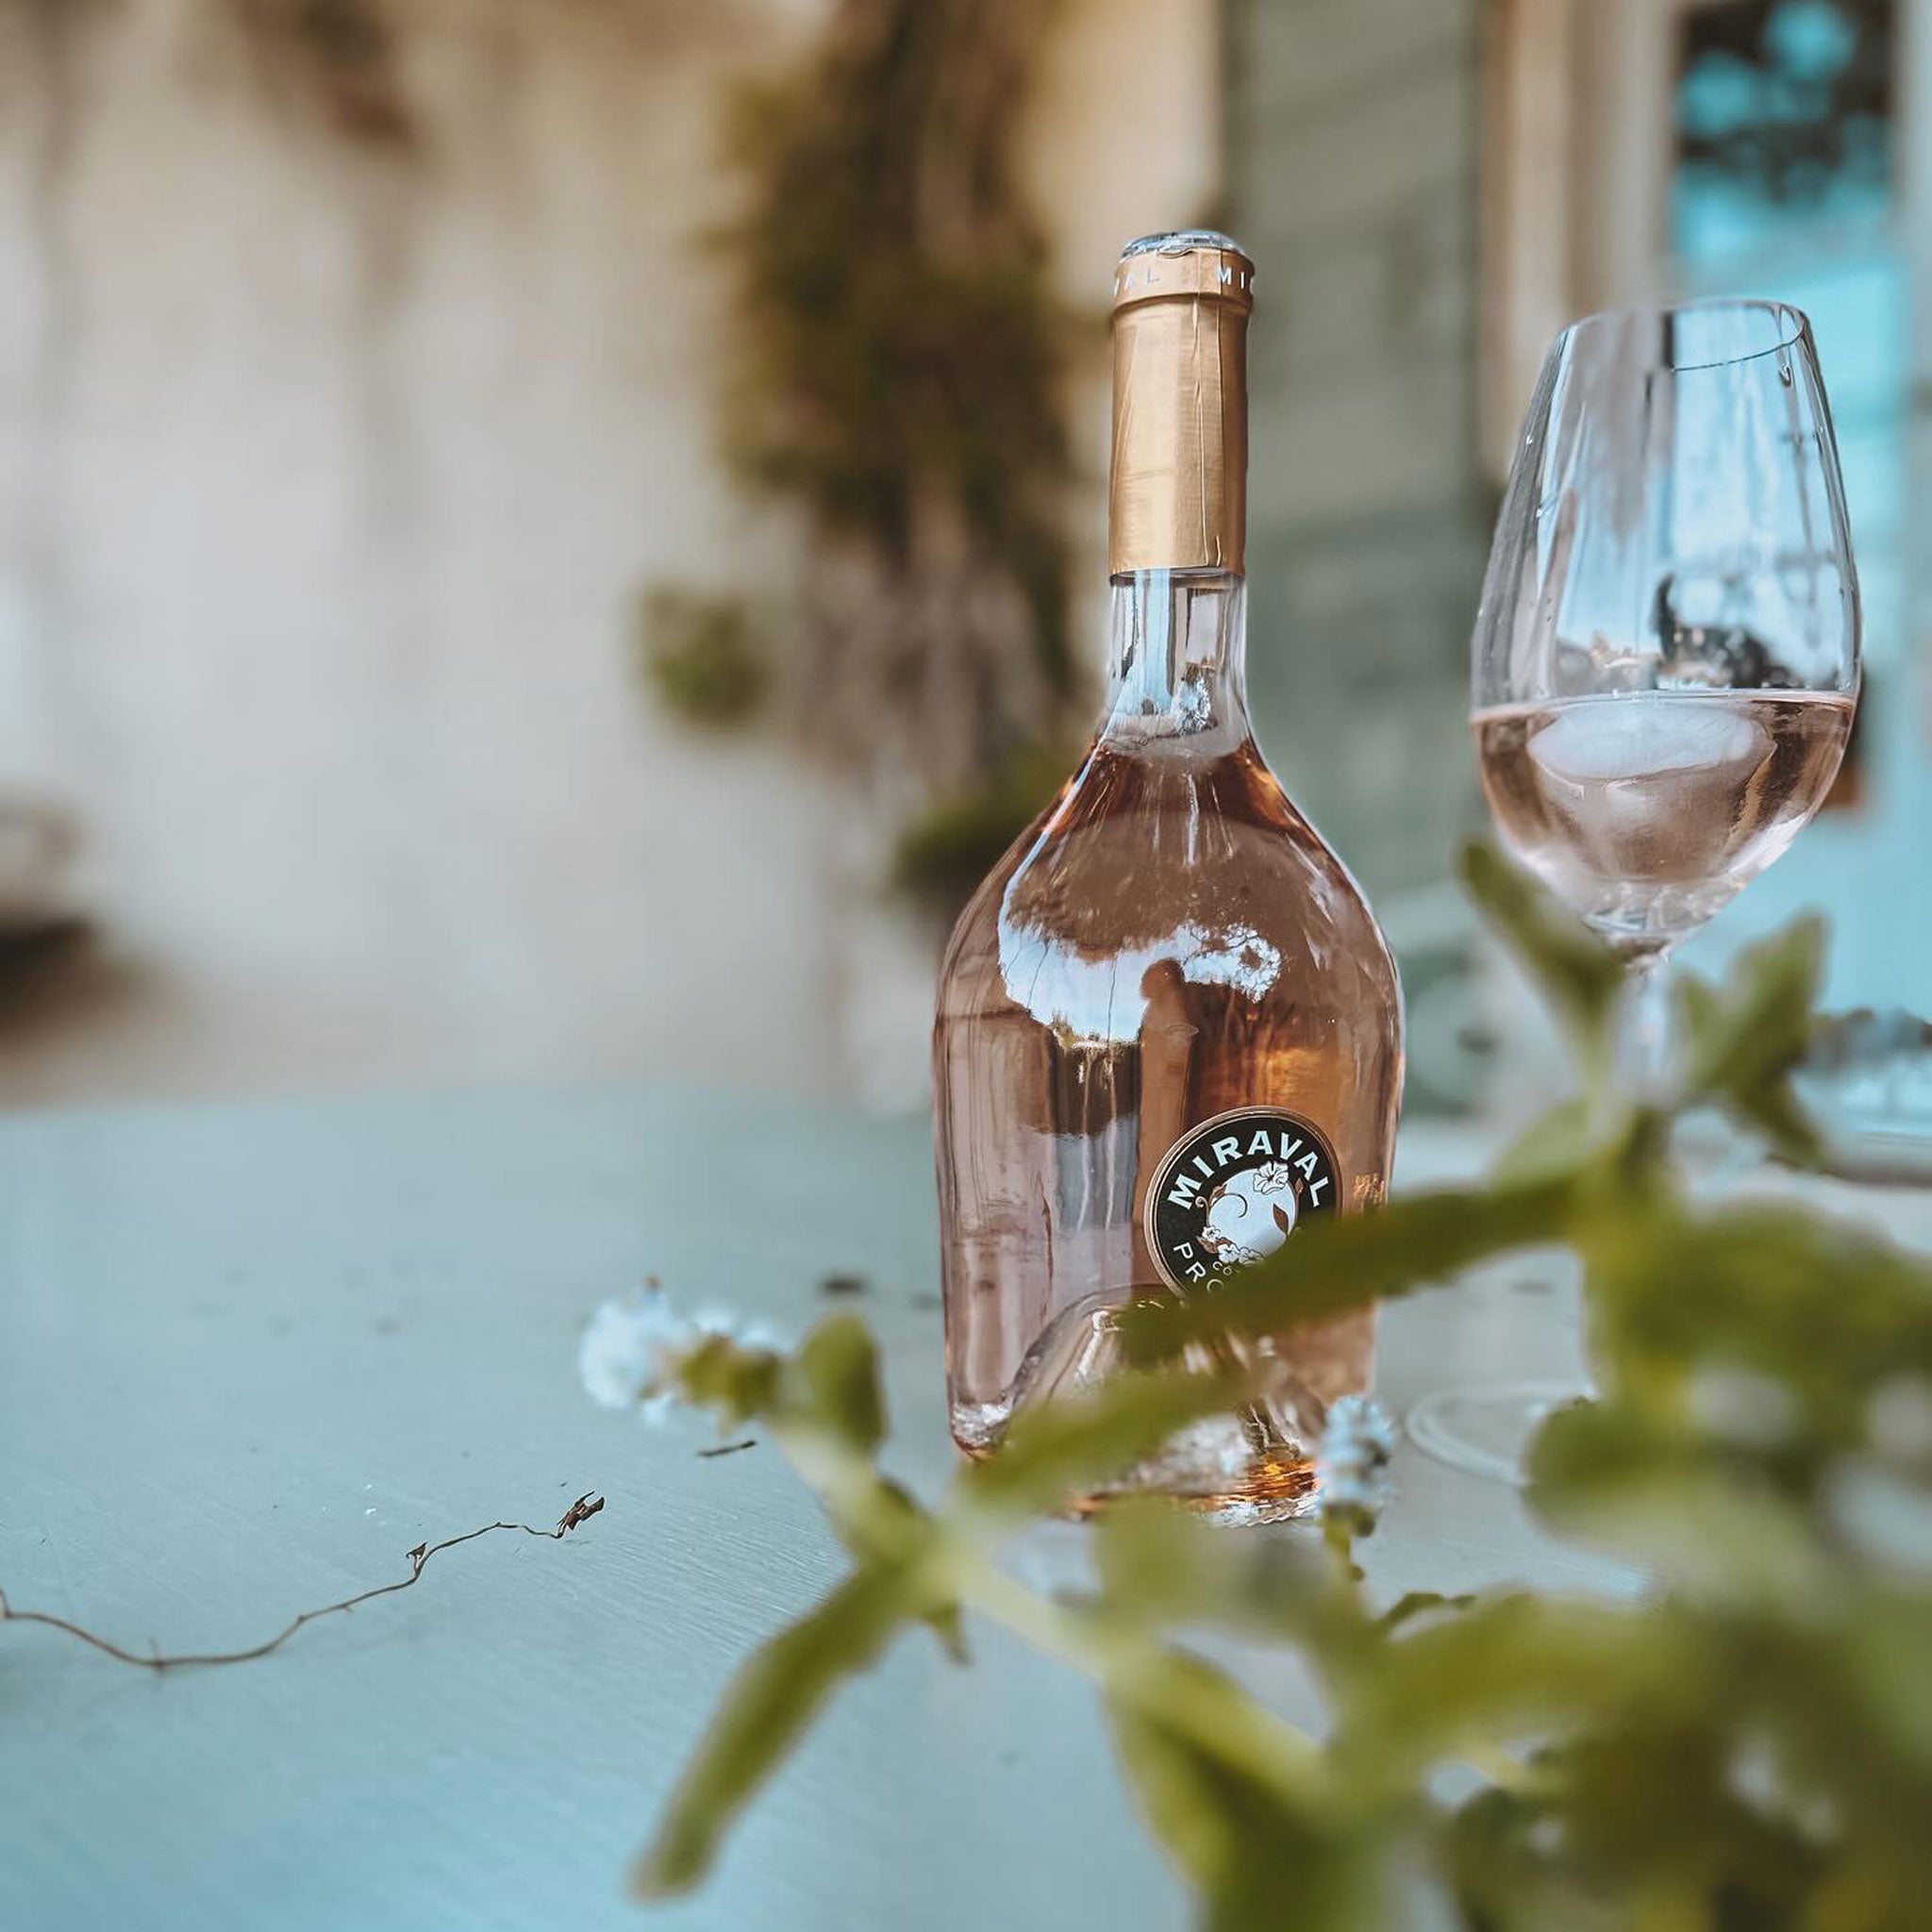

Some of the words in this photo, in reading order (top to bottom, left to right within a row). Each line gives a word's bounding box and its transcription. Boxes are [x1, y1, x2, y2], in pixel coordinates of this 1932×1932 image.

[1215, 266, 1254, 291] MI
[1167, 1130, 1329, 1209] MIRAVAL
[1173, 1241, 1224, 1294] PRO
